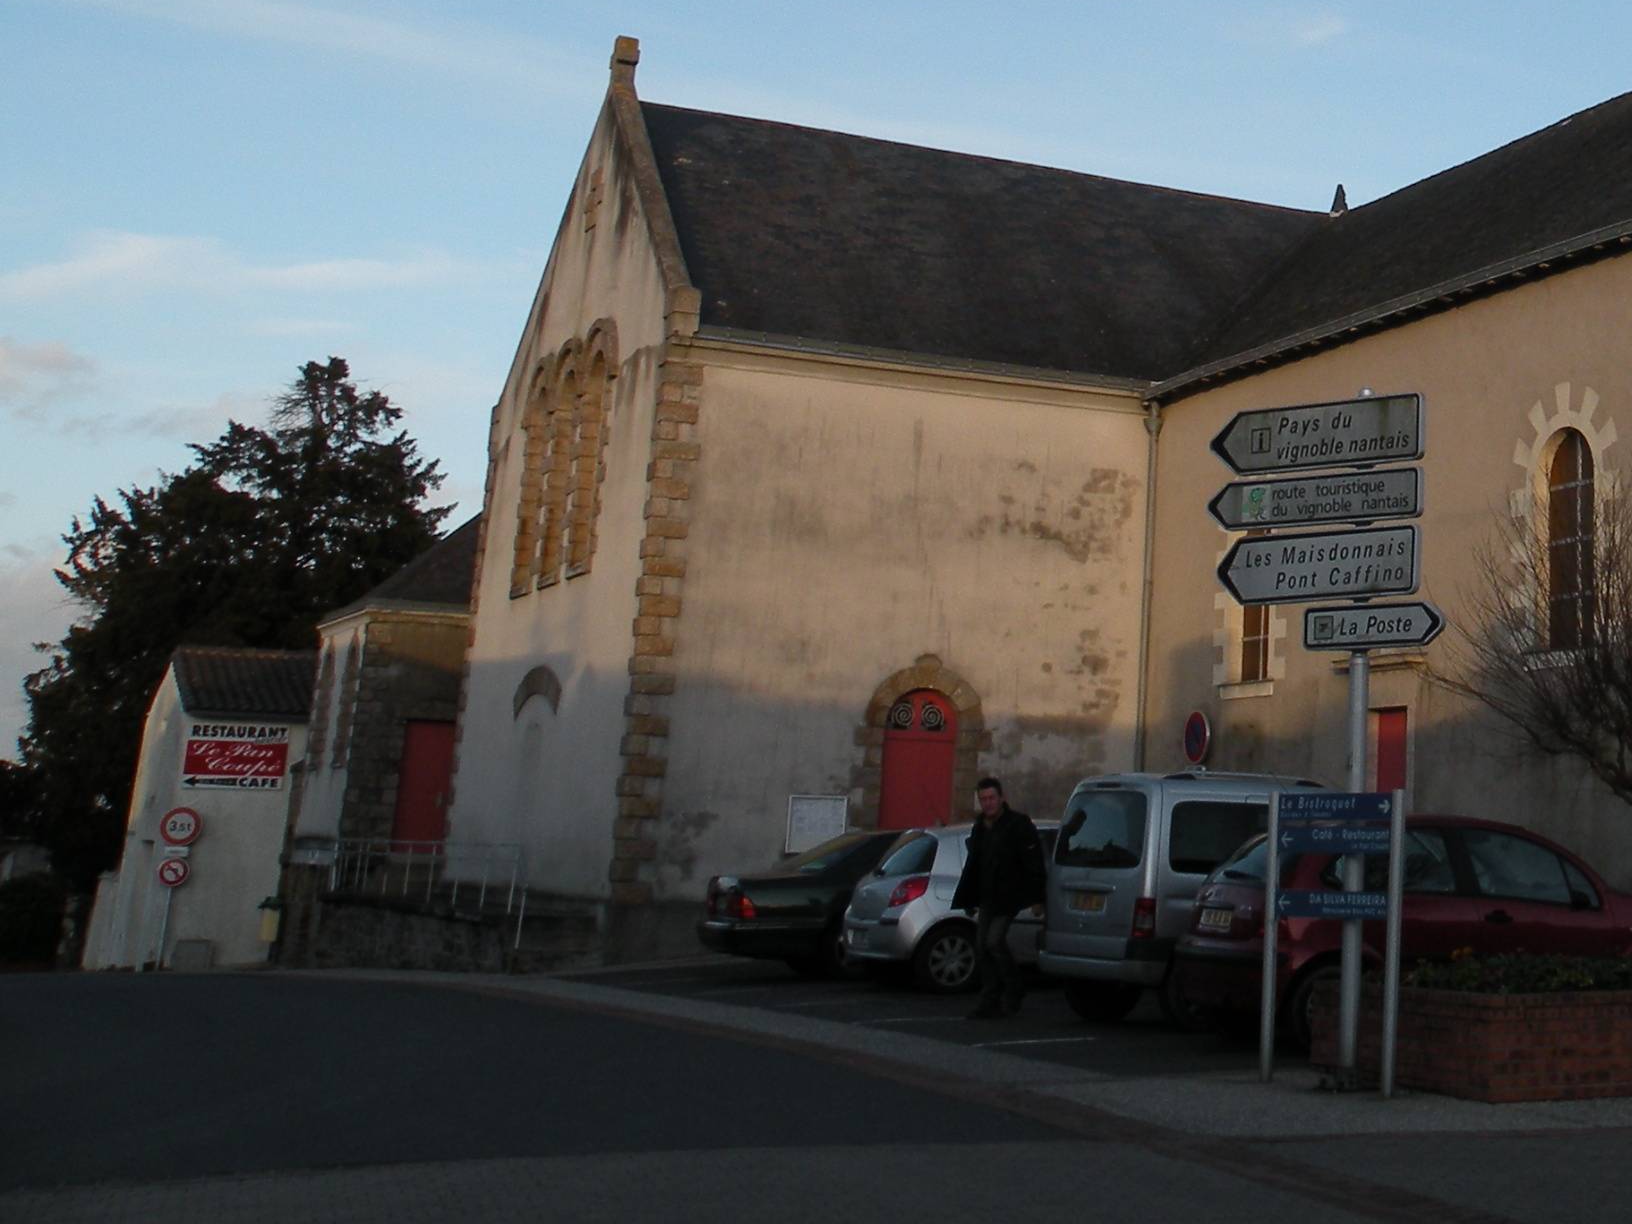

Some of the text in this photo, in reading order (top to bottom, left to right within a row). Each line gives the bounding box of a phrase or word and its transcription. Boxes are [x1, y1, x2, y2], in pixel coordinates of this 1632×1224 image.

[1277, 411, 1352, 435] Pays du
[1276, 431, 1410, 463] vignoble nantais
[1272, 478, 1385, 502] route touristique
[1272, 493, 1409, 519] du vignoble nantais
[1246, 539, 1405, 568] Les Maisdonnais
[1276, 564, 1404, 590] Pont Caffino
[1339, 615, 1413, 636] La Poste
[192, 725, 288, 738] RESTAURANT
[192, 743, 220, 755] Le
[238, 777, 279, 788] CAFE
[1280, 797, 1293, 809] Le
[1342, 829, 1390, 841] Restaurant
